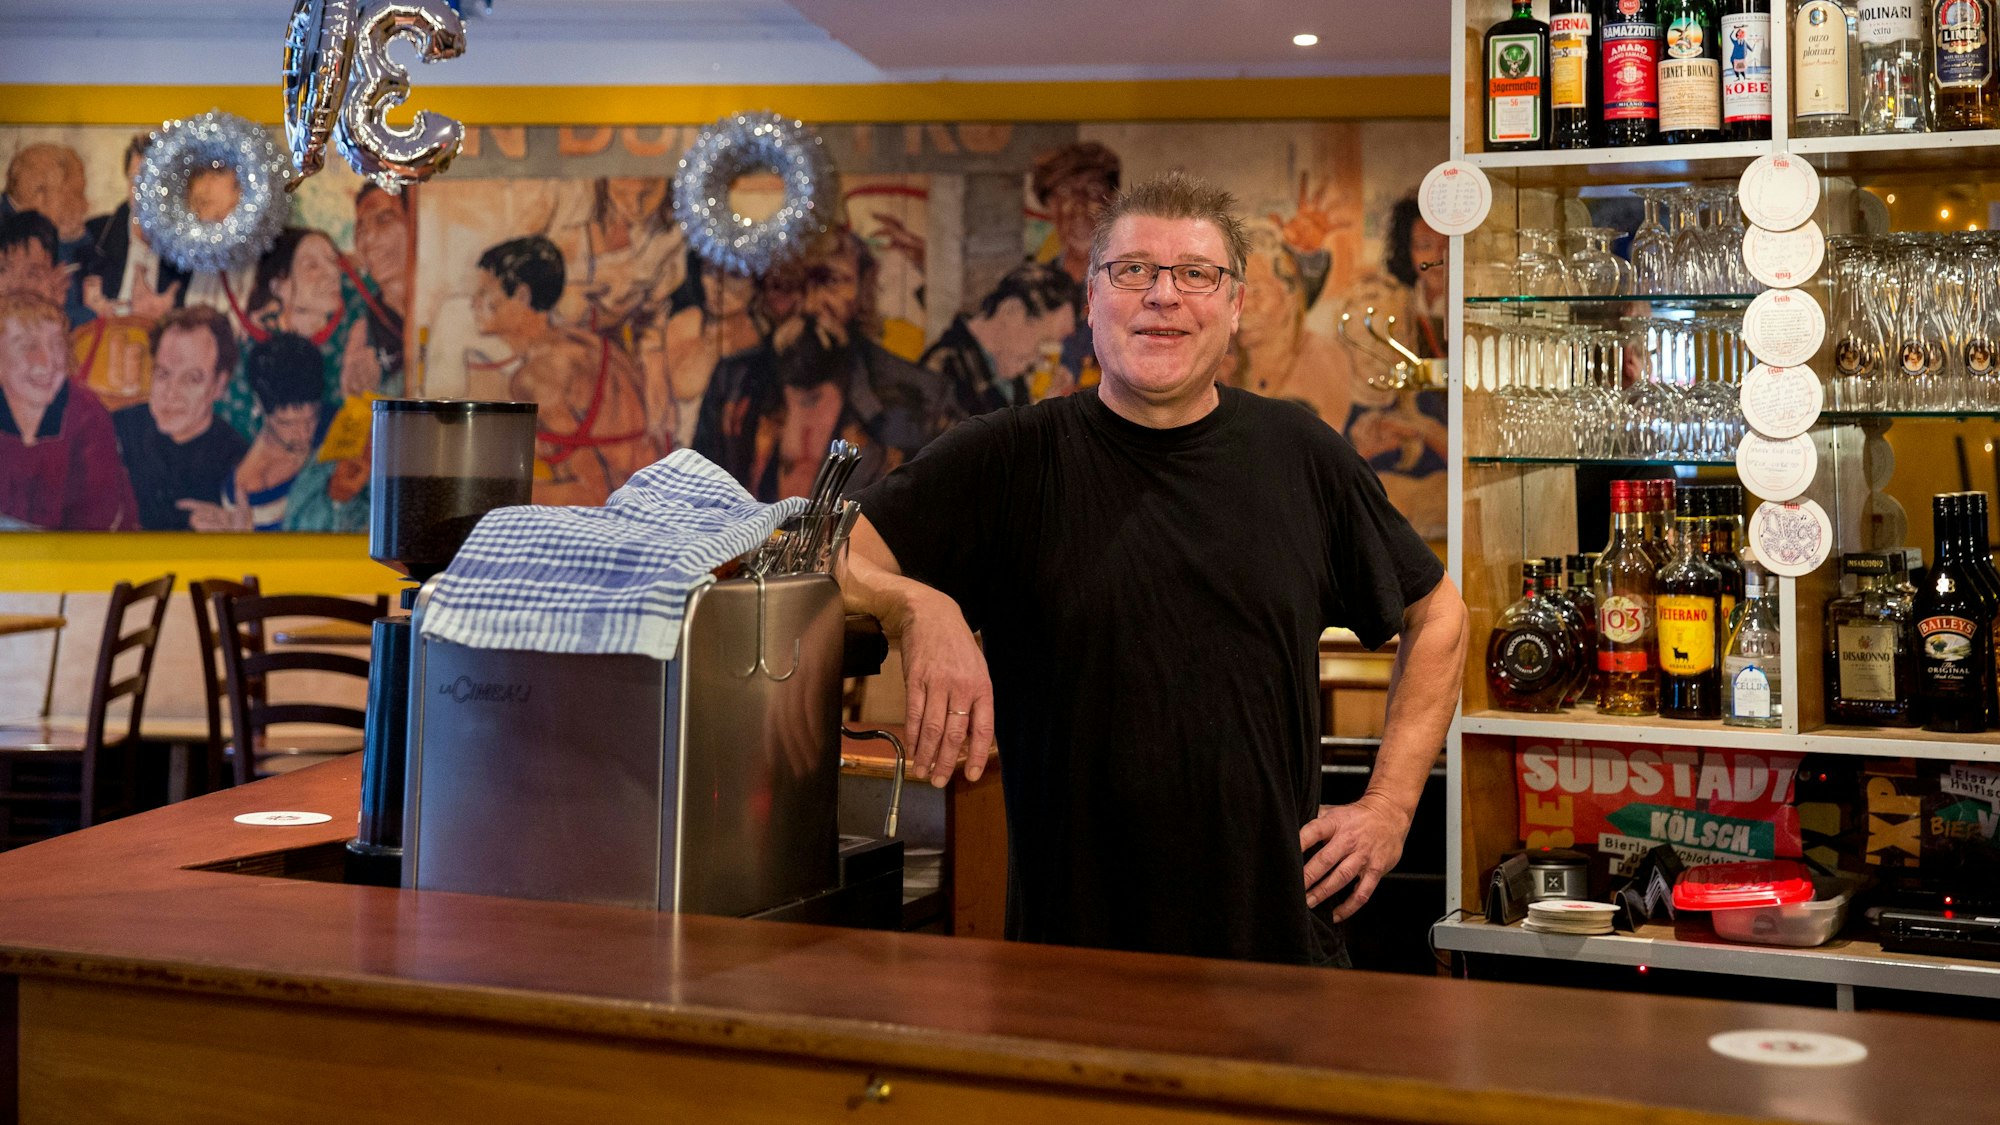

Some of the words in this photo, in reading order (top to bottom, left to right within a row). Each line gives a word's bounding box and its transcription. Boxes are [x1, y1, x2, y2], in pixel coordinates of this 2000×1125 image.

[1859, 6, 1911, 21] MOLINARI
[1549, 18, 1589, 32] VERNA
[1603, 25, 1656, 38] RAMAZZOTTI
[1873, 27, 1891, 35] extra
[1611, 43, 1648, 56] AMARO
[1803, 46, 1836, 60] plomari
[1725, 82, 1772, 96] KOBE
[1659, 605, 1707, 621] VETERANO
[1600, 608, 1641, 633] 103
[1920, 618, 1973, 633] BAILEYS
[1842, 651, 1889, 661] DISARONNO
[1523, 740, 1798, 803] SÜDSTADT
[1650, 809, 1758, 857] KÖLSCH,
